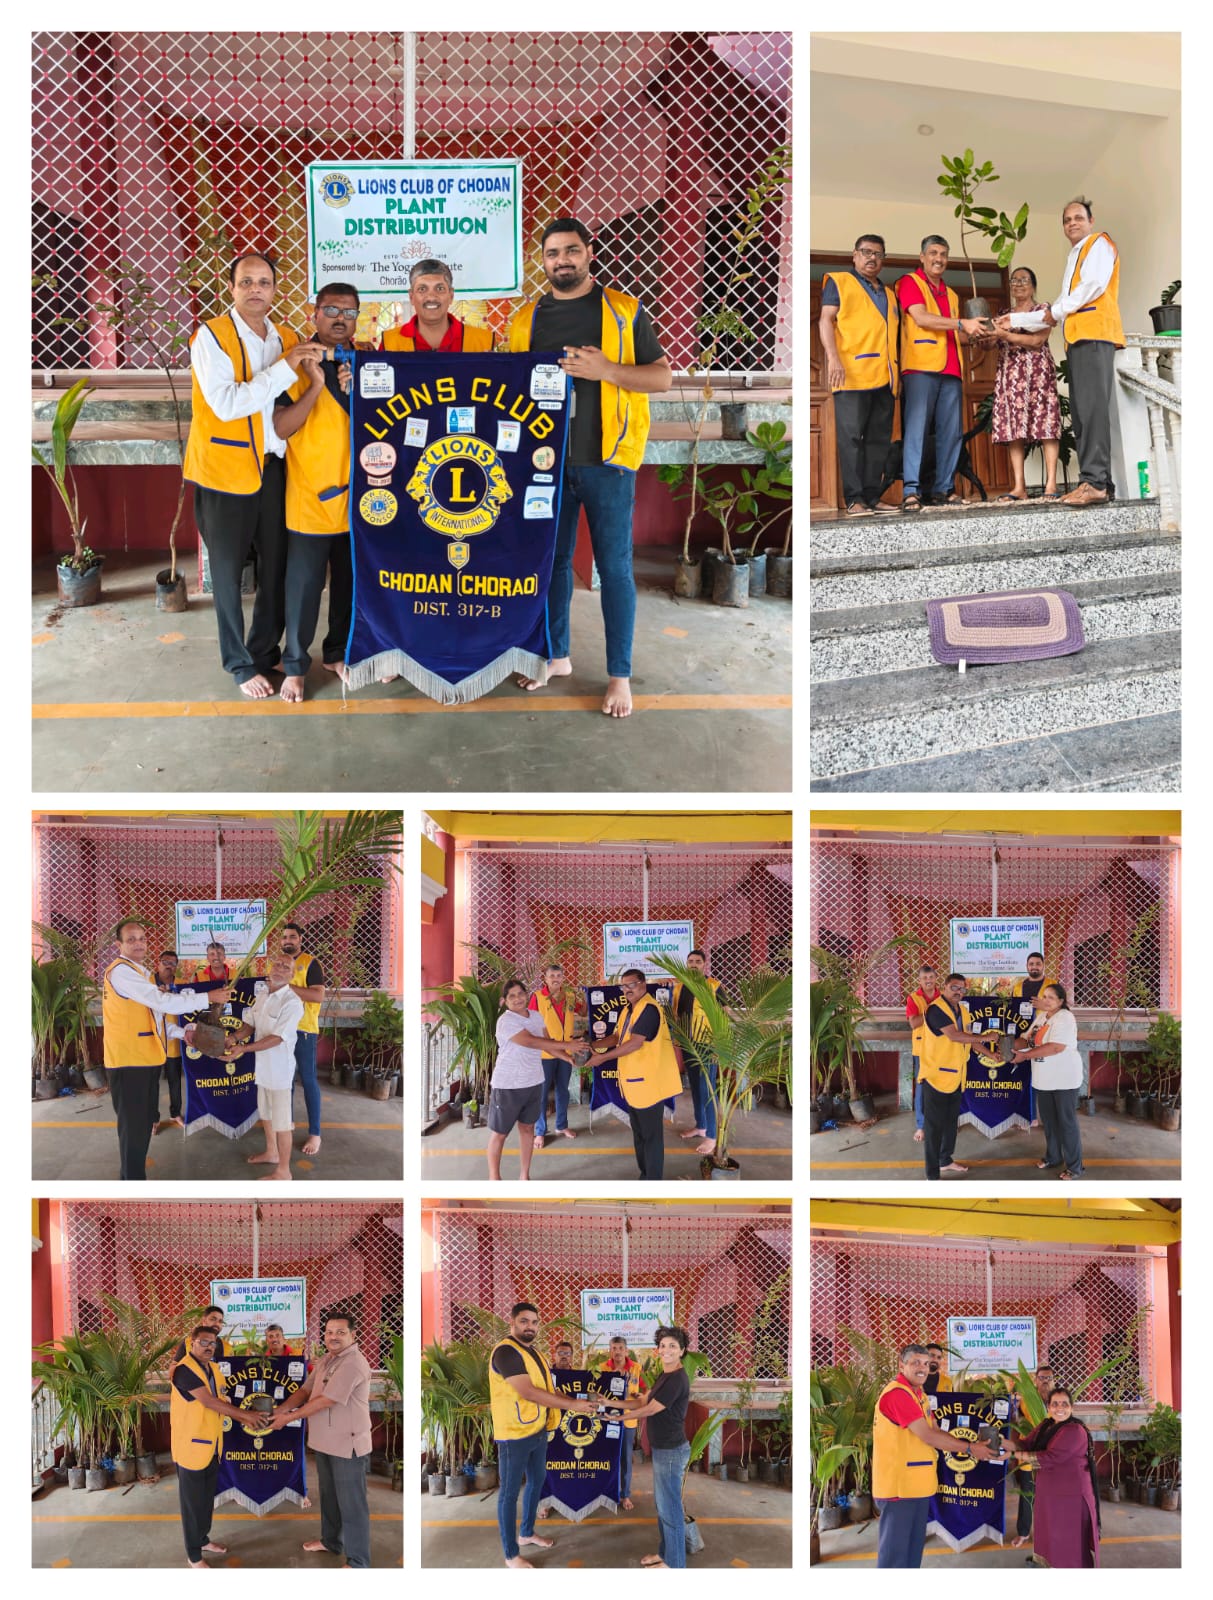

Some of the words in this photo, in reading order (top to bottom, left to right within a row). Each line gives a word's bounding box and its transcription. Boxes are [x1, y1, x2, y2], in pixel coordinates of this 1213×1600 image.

[358, 179, 396, 195] LIONS
[401, 178, 434, 195] CLUB
[440, 178, 454, 194] OF
[458, 176, 511, 193] CHODAN
[386, 197, 446, 214] PLANT
[344, 216, 488, 236] DISTRIBUTIUON
[322, 263, 356, 273] Sponsored
[357, 263, 366, 272] by:
[370, 262, 390, 272] The
[392, 262, 412, 274] Yog
[380, 276, 407, 286] Chorão
[364, 377, 457, 440] LIONS
[470, 377, 554, 440] CLUB
[430, 440, 492, 462] LIONS
[449, 467, 476, 503] L
[362, 492, 375, 507] NEW
[430, 511, 487, 530] INTERNATIONAL
[378, 570, 452, 594] CHODAN
[456, 570, 538, 597] (CHORAO)
[414, 601, 450, 616] DIST.
[458, 602, 502, 618] 317-B
[593, 995, 628, 1021] LIONS
[998, 1007, 1029, 1030] CLUB
[196, 1077, 230, 1088] CHODAN
[966, 1081, 990, 1089] HODAN
[226, 1367, 258, 1390] IONS
[263, 1368, 299, 1394] CLUB
[934, 1402, 962, 1419] ONS
[576, 1418, 588, 1433] L
[954, 1430, 976, 1441] IONS
